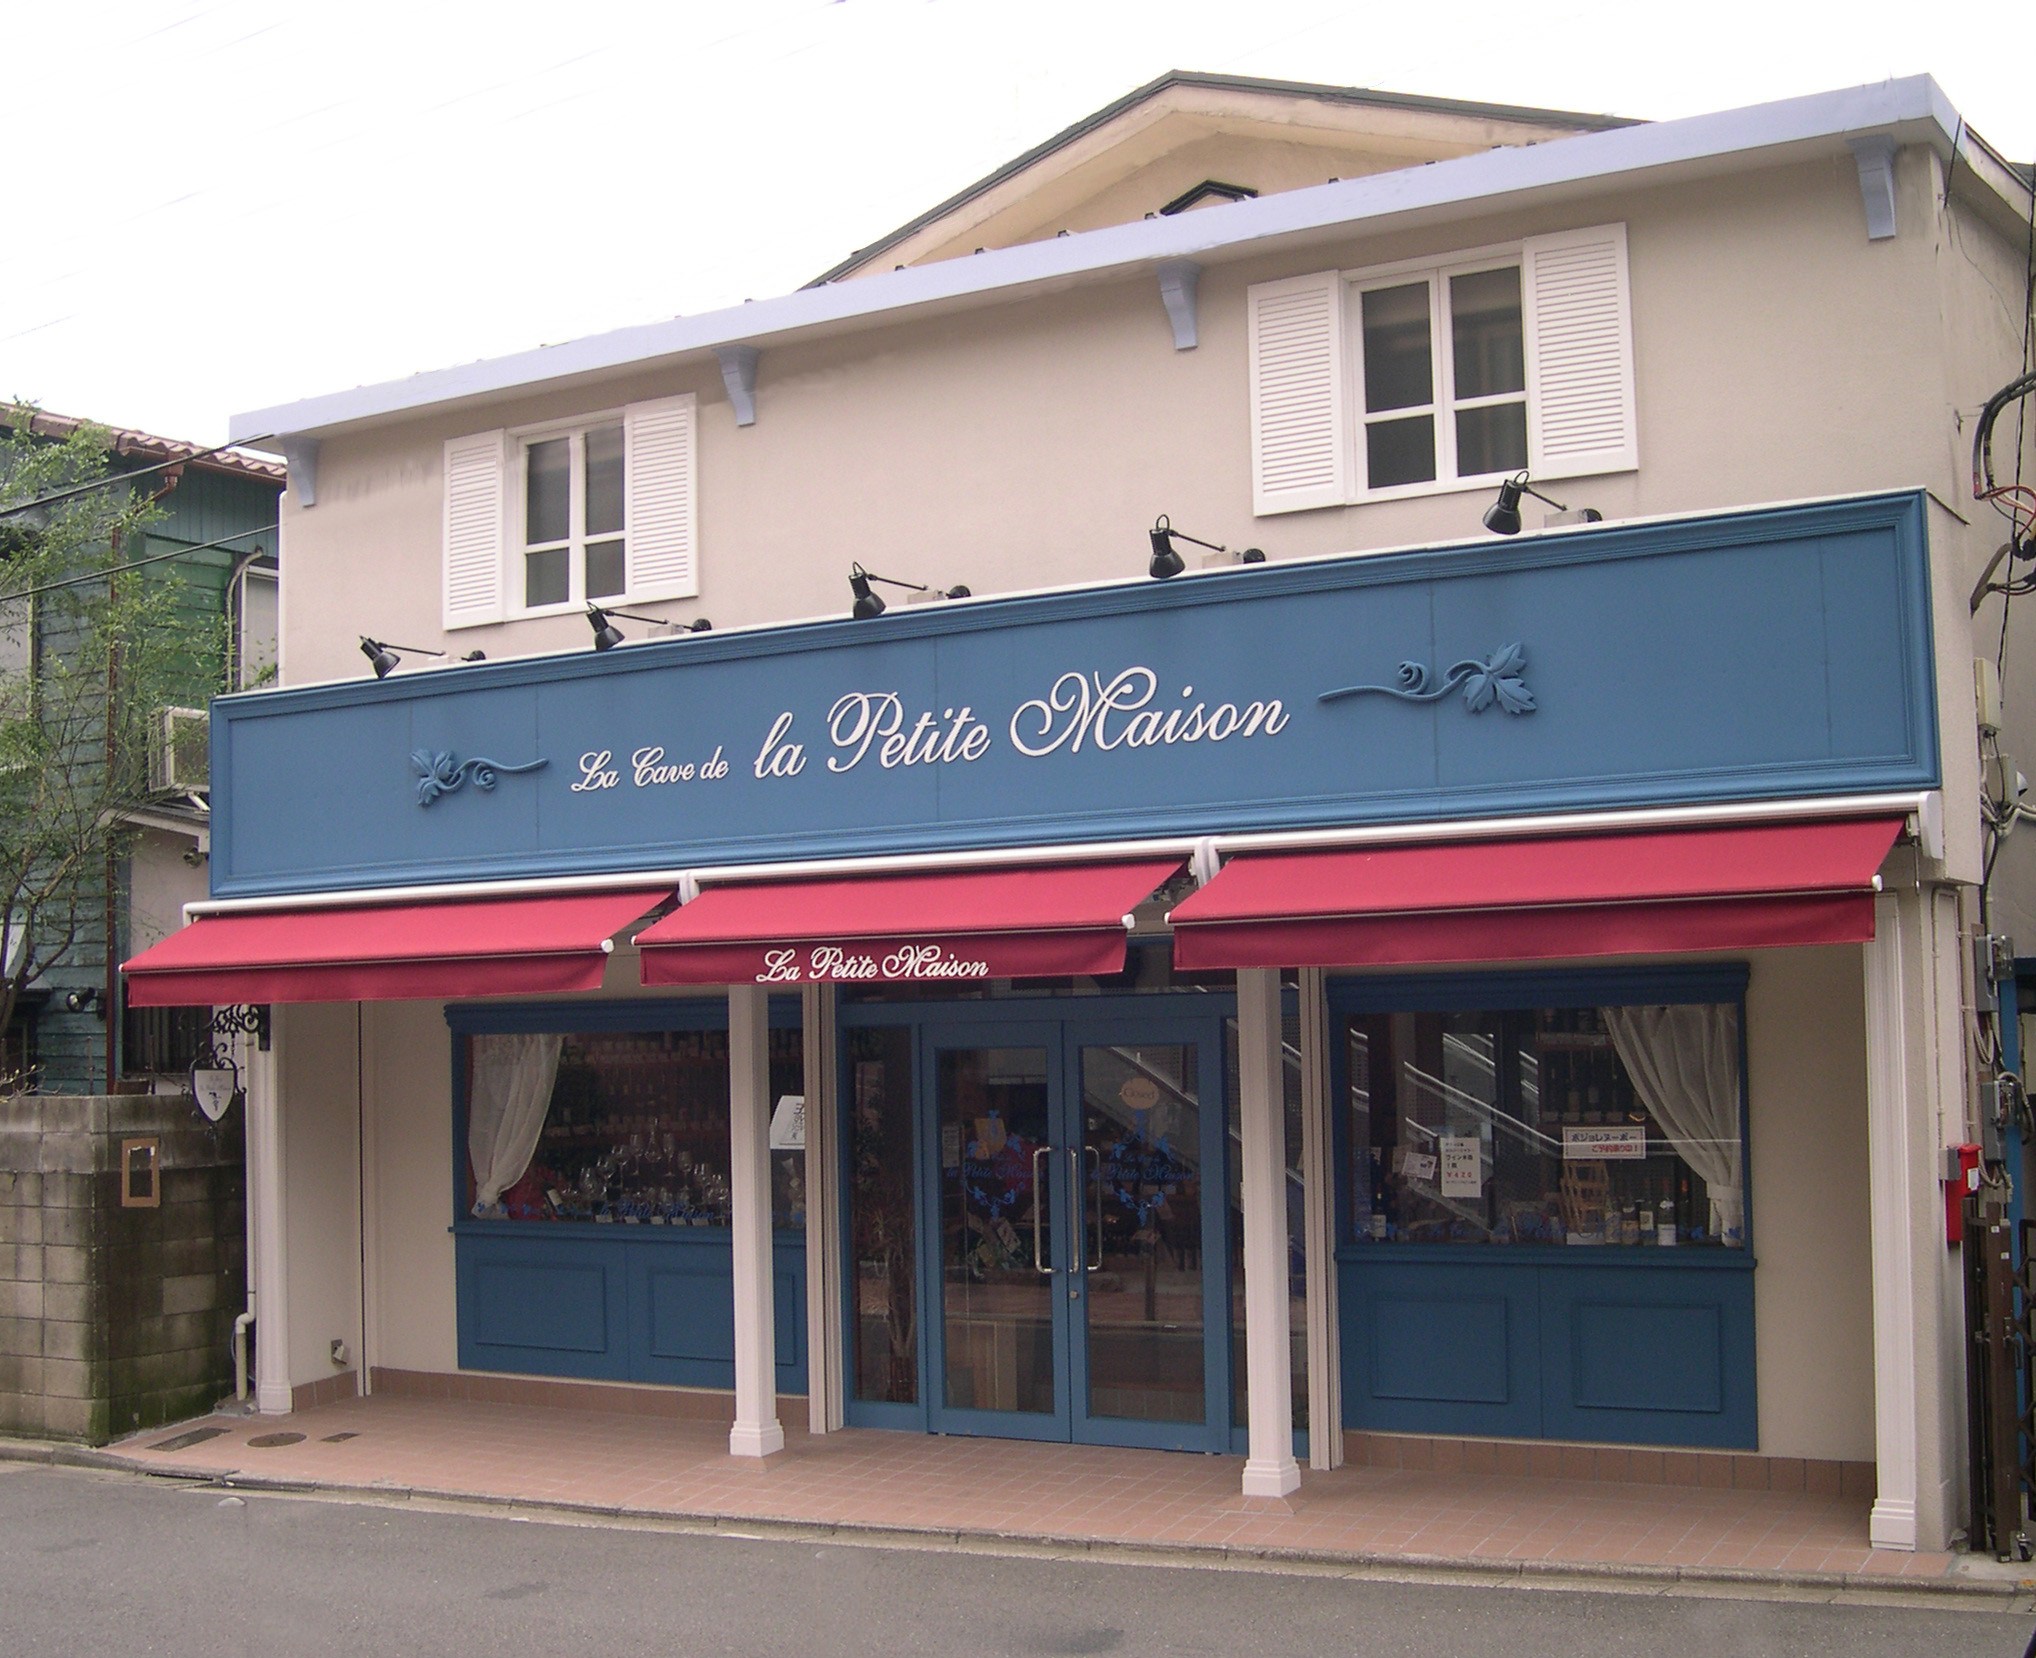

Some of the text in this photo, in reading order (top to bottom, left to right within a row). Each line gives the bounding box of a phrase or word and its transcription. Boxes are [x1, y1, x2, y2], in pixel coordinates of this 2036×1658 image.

[571, 666, 1290, 791] La Cave de la Petite Maison
[755, 944, 989, 983] La Petite Maison
